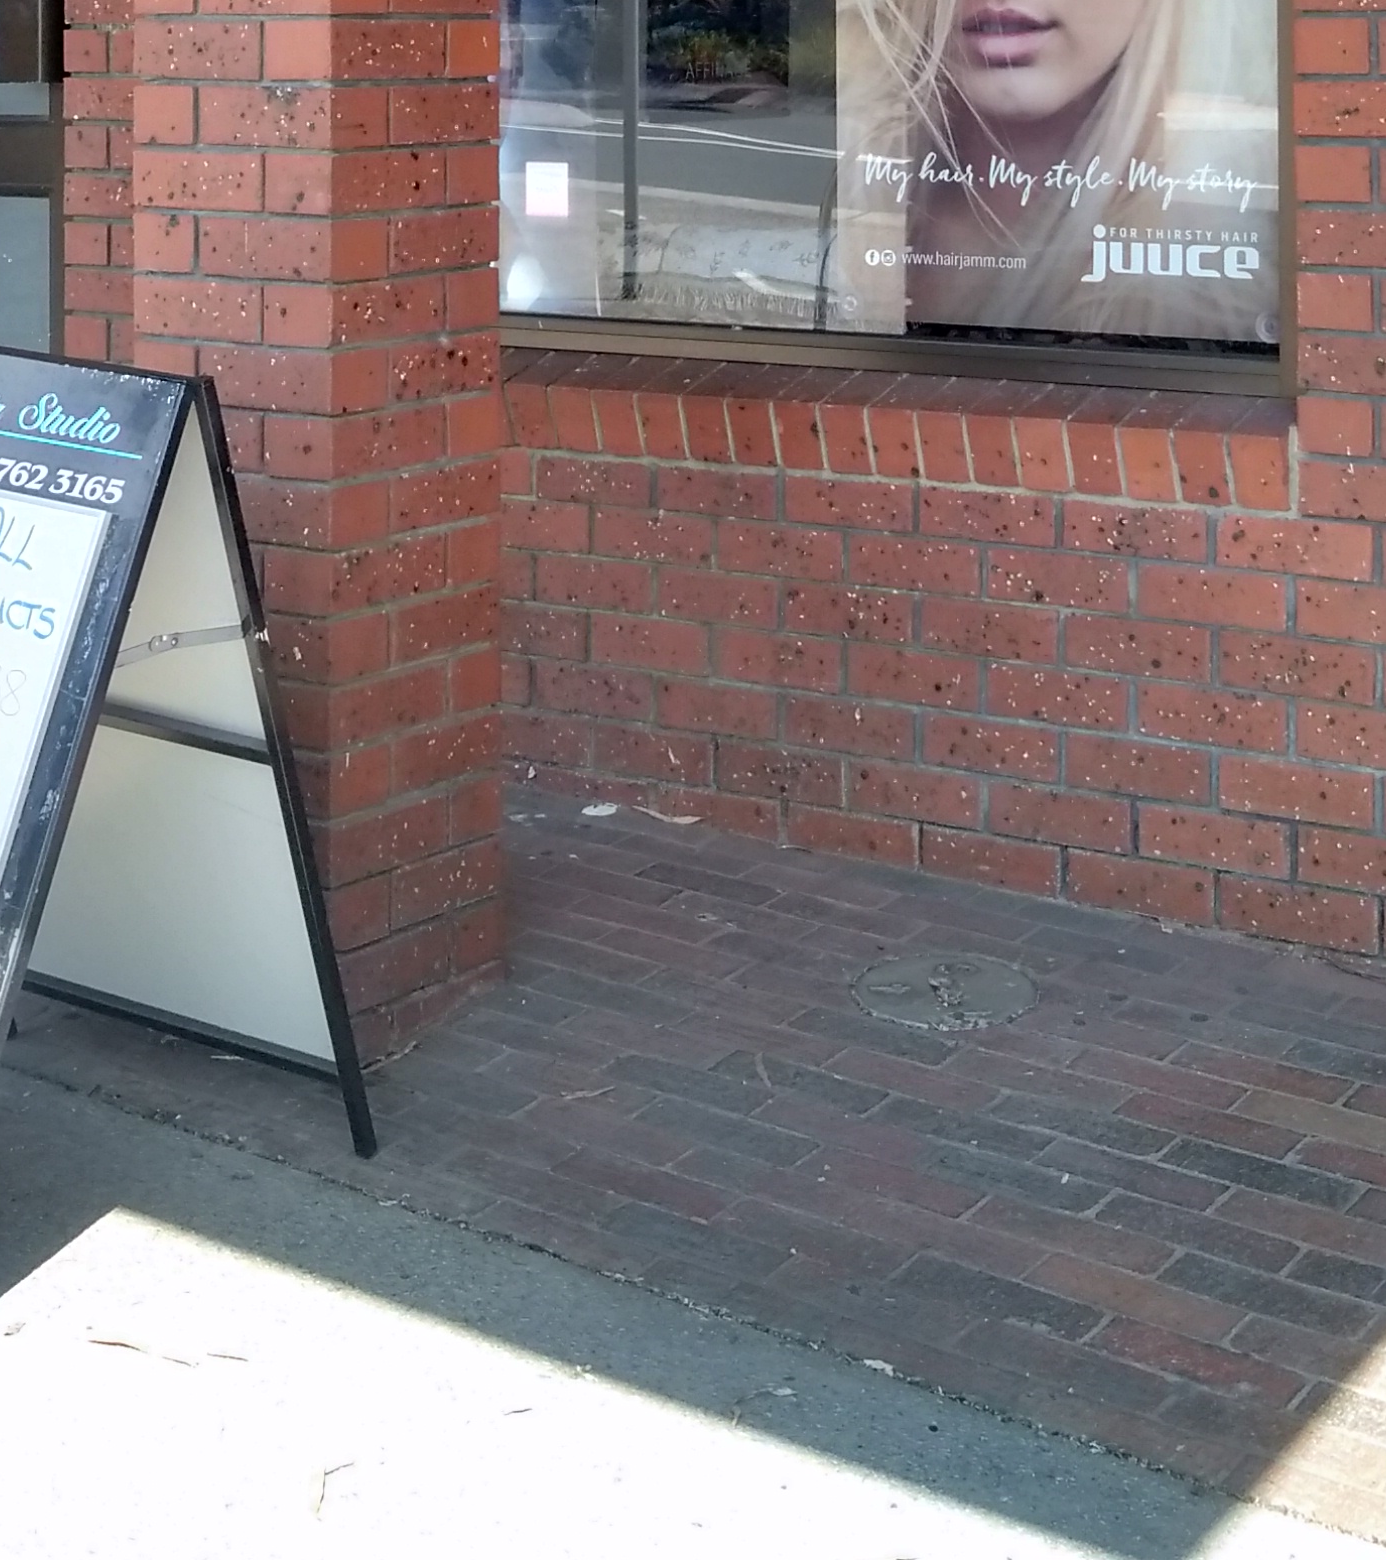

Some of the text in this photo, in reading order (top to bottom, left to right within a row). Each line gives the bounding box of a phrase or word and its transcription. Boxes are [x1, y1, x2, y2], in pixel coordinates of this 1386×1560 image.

[864, 153, 913, 203] My
[988, 154, 1037, 206] My
[1128, 156, 1177, 211] My
[1184, 161, 1258, 213] story
[1080, 223, 1261, 283] juuce
[1109, 226, 1260, 244] FOR THIRSTY HAIR
[901, 250, 1027, 271] www.hairjamm.com
[18, 392, 121, 444] Studio
[47, 468, 126, 505] 3165
